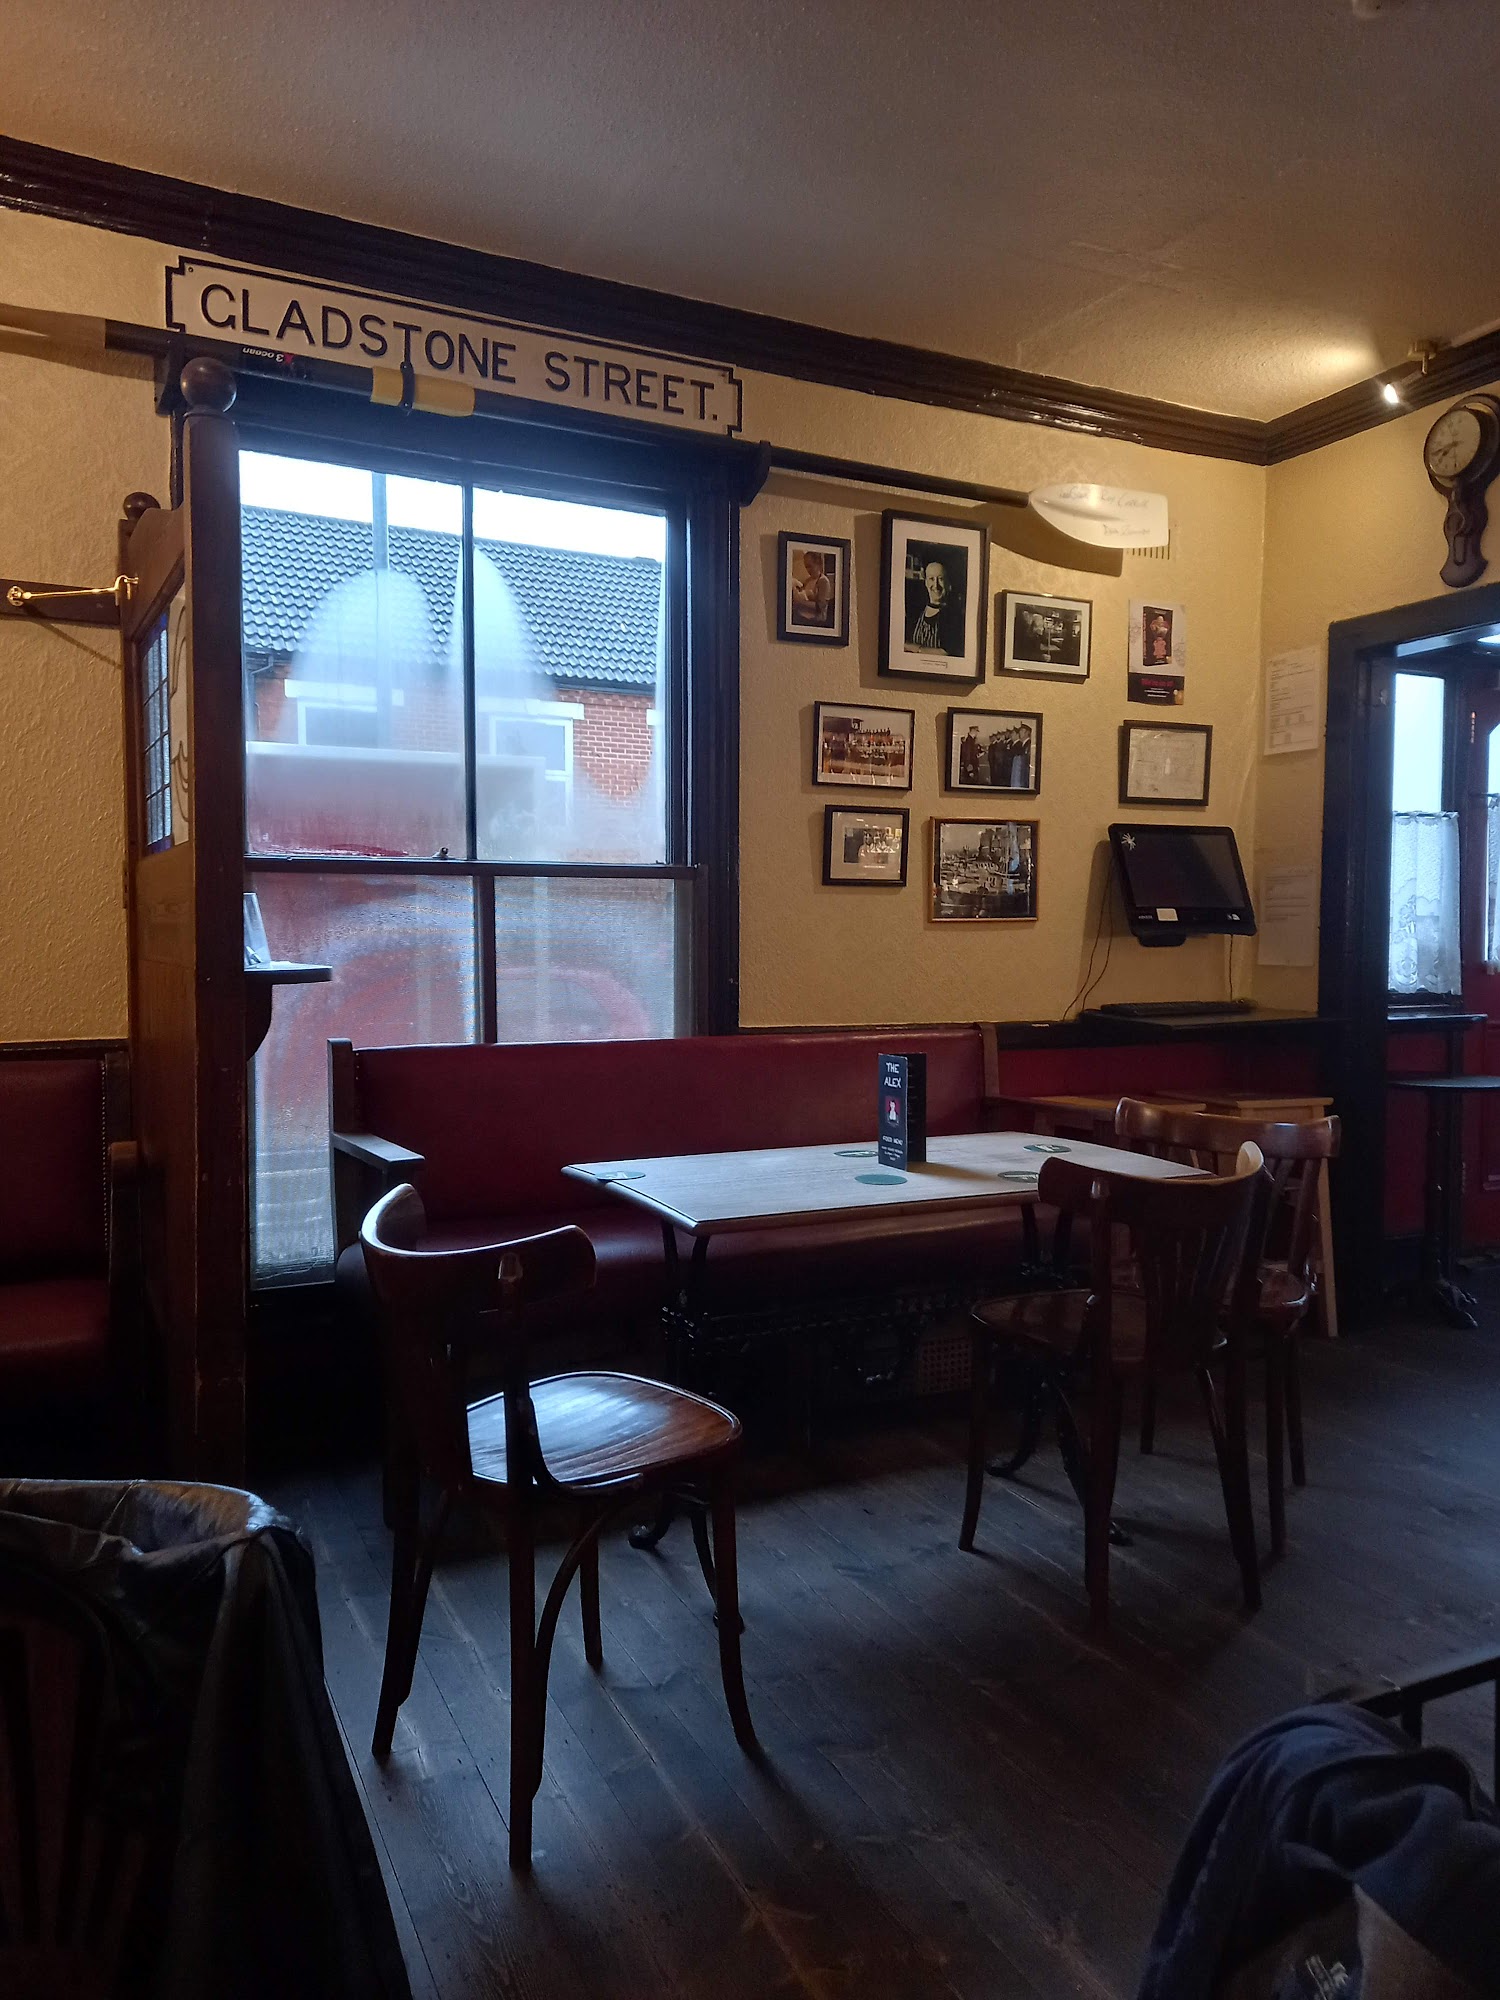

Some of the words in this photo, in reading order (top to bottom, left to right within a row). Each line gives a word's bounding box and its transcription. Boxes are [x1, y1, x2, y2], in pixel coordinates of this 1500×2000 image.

[200, 283, 517, 384] GLADSTONE
[545, 351, 719, 422] STREET.
[276, 354, 284, 362] 3
[885, 1062, 900, 1074] THE
[883, 1076, 902, 1089] ALEX
